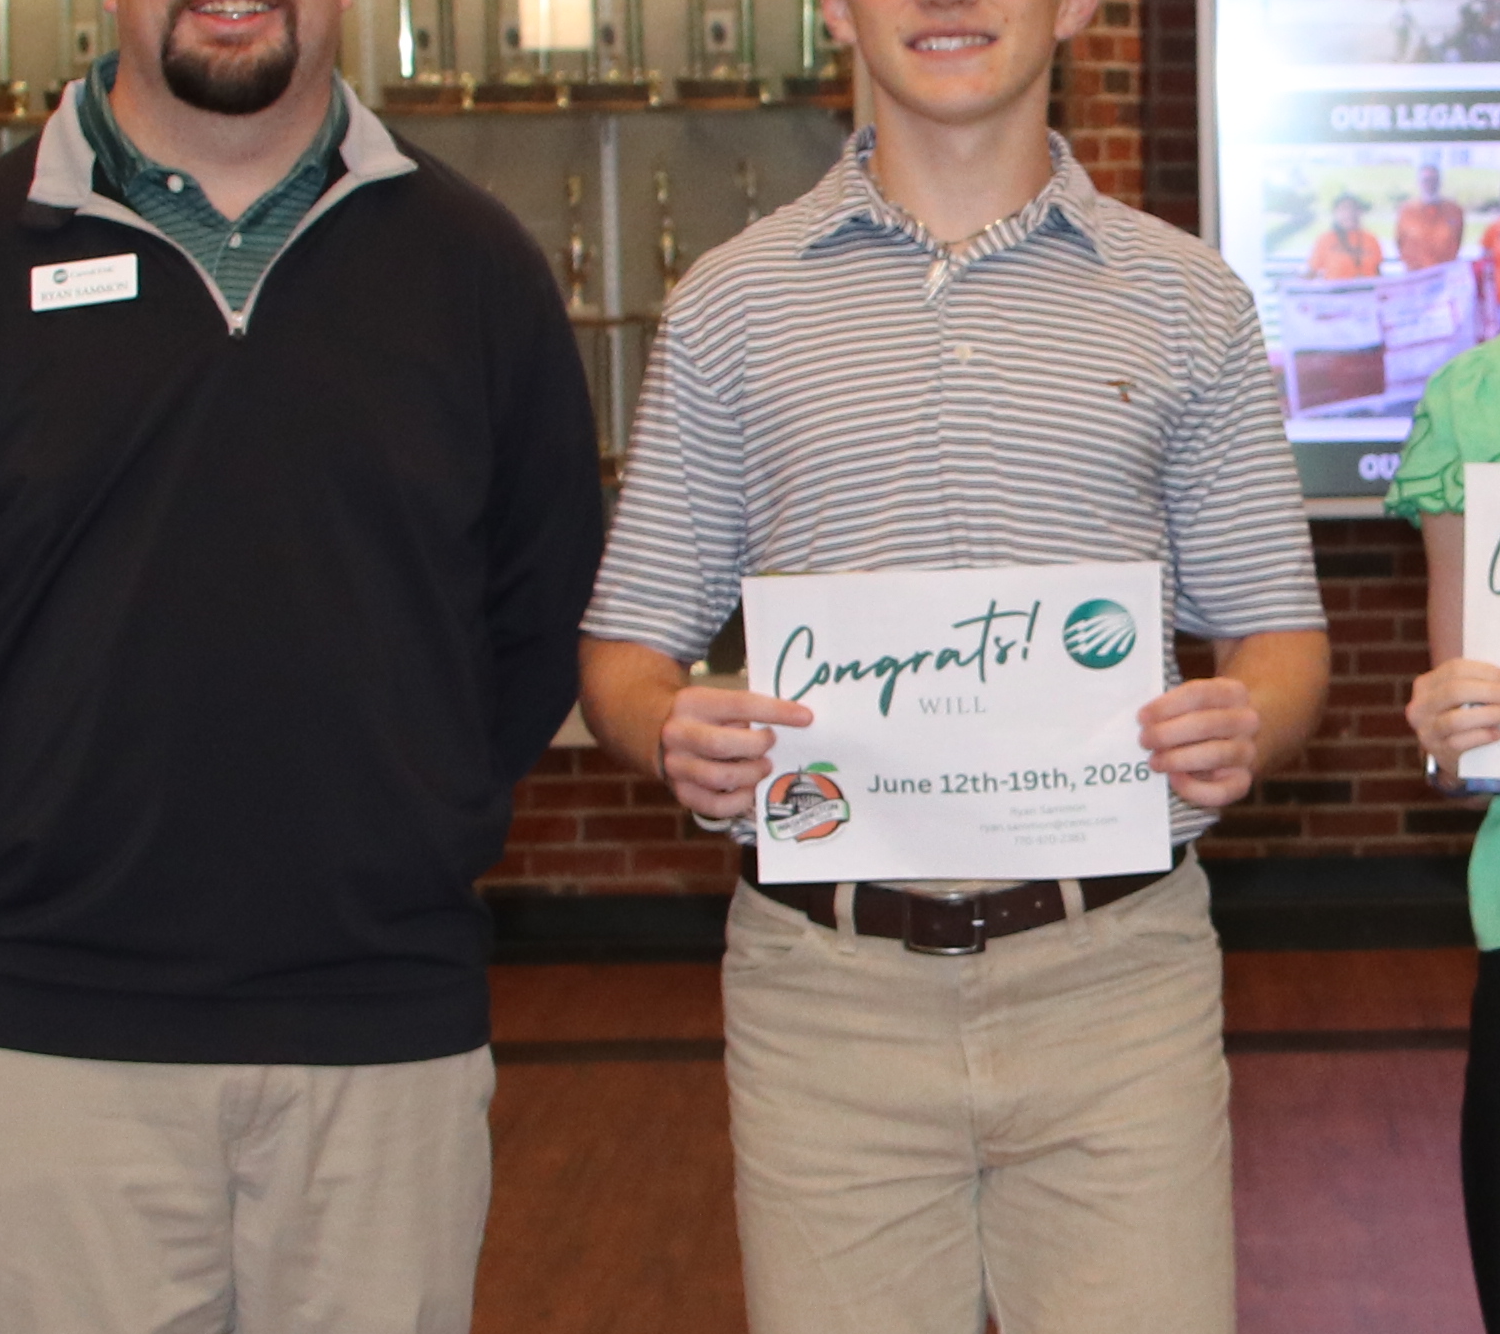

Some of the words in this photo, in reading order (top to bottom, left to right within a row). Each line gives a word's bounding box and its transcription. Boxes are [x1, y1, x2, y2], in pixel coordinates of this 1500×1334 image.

[1331, 104, 1392, 130] OUR
[1358, 453, 1401, 481] OU
[773, 598, 1042, 717] Congrats!
[919, 696, 987, 716] WILL
[867, 772, 932, 797] June
[939, 766, 1077, 794] 12th-19th,
[1084, 761, 1150, 786] 2026
